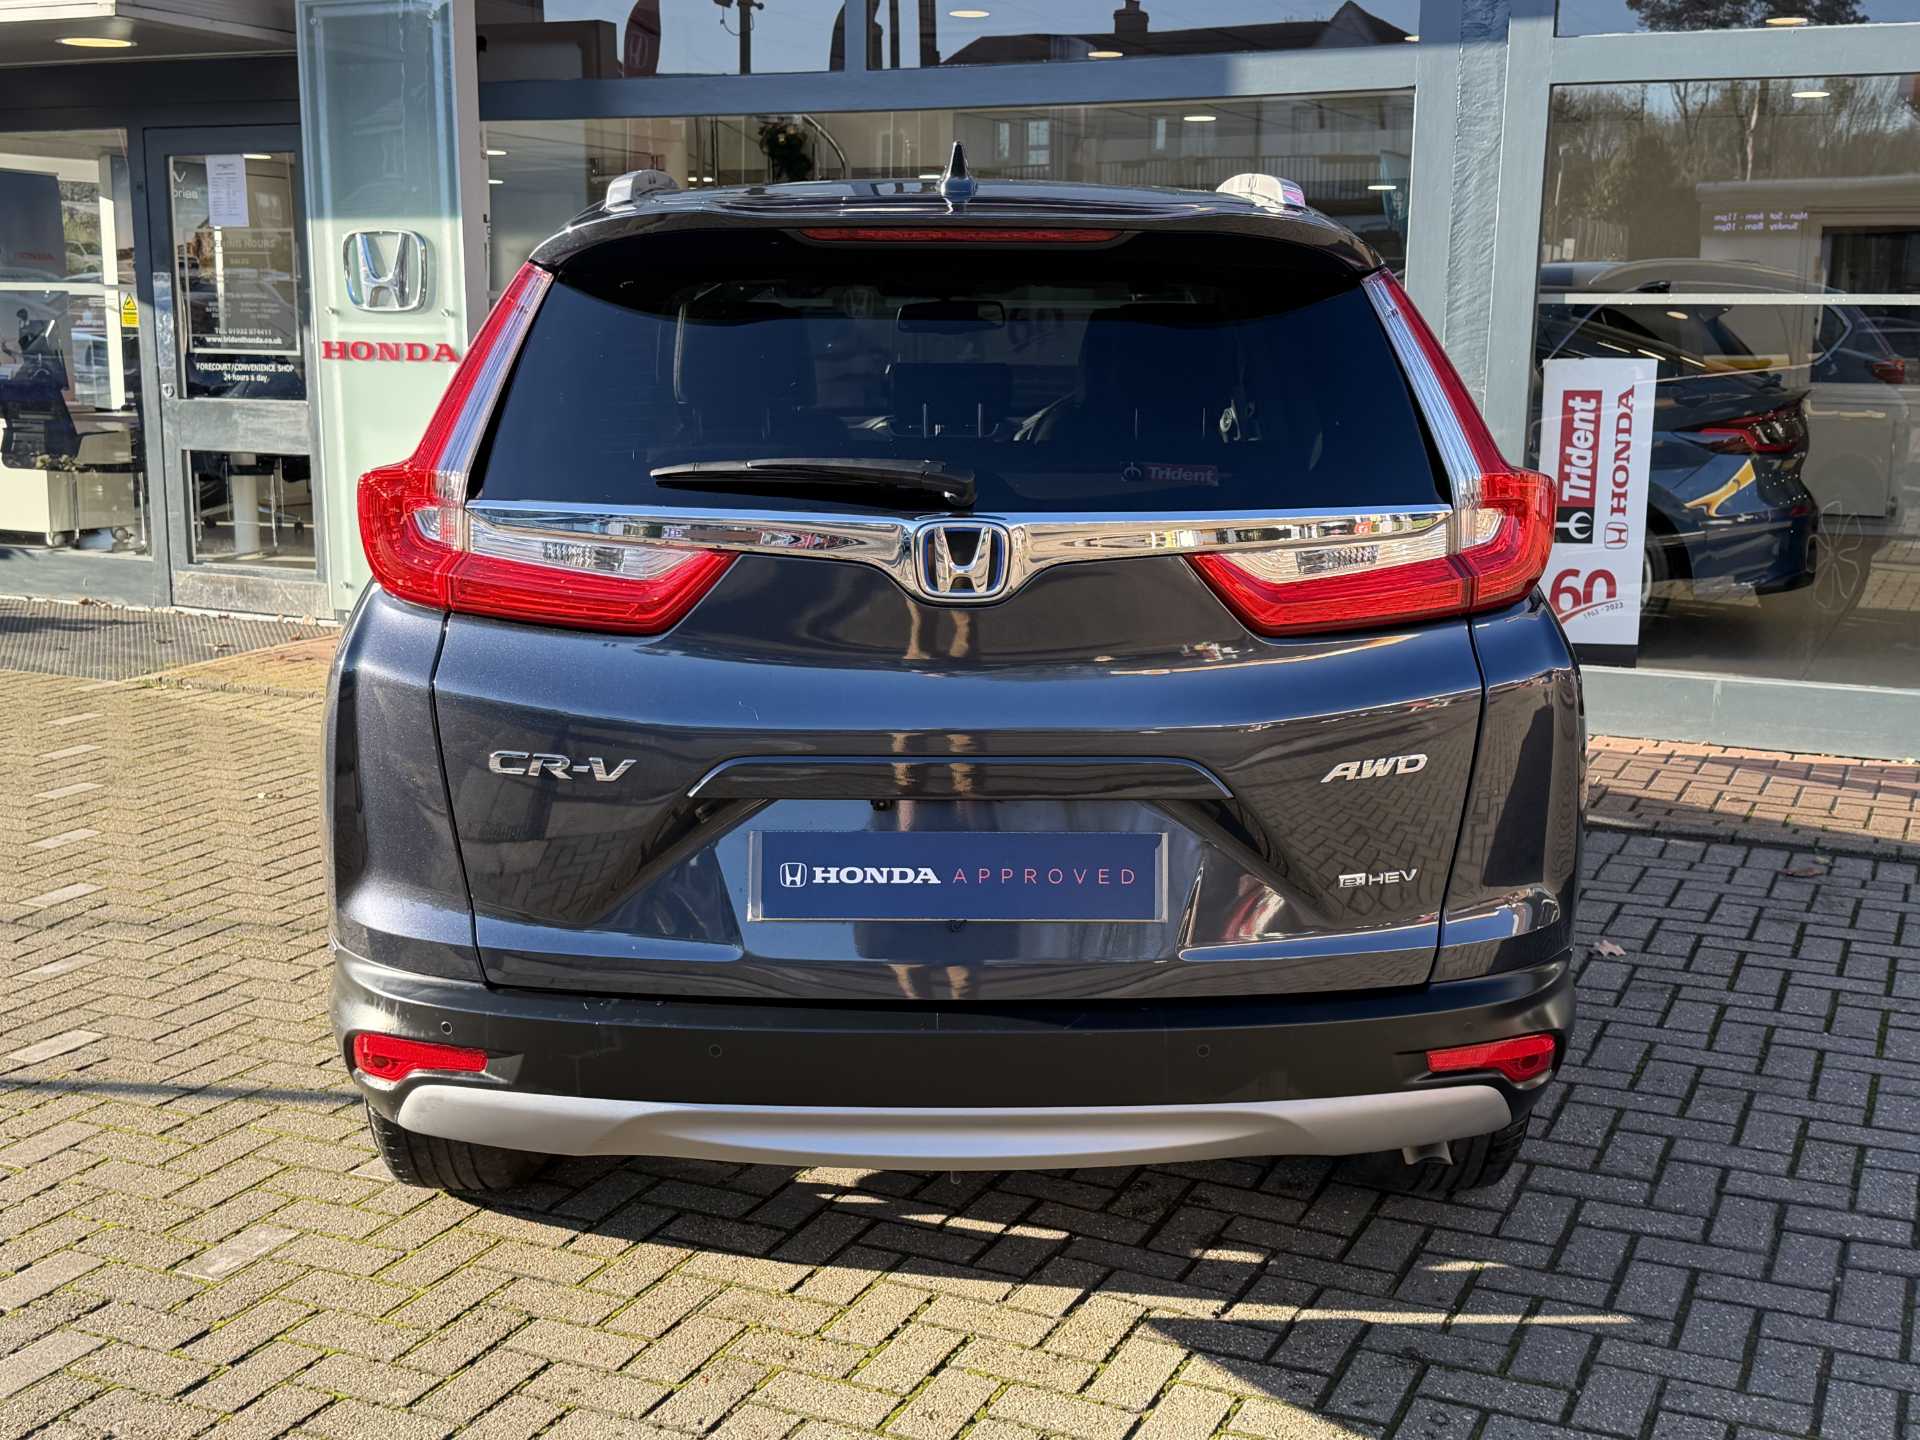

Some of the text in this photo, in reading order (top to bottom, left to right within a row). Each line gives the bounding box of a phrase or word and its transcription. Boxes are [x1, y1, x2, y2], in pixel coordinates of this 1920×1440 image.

[321, 340, 461, 363] HONDA
[232, 373, 249, 381] hours
[278, 363, 294, 372] SHOP
[1562, 396, 1598, 502] Trident
[1610, 384, 1636, 517] HONDA
[1149, 466, 1216, 481] Trident
[1548, 568, 1617, 617] 60
[1605, 601, 1625, 612] 2023
[488, 750, 637, 782] CR-V
[1320, 754, 1429, 784] AWD
[812, 866, 942, 885] HONDA
[952, 867, 1136, 885] APPROVED
